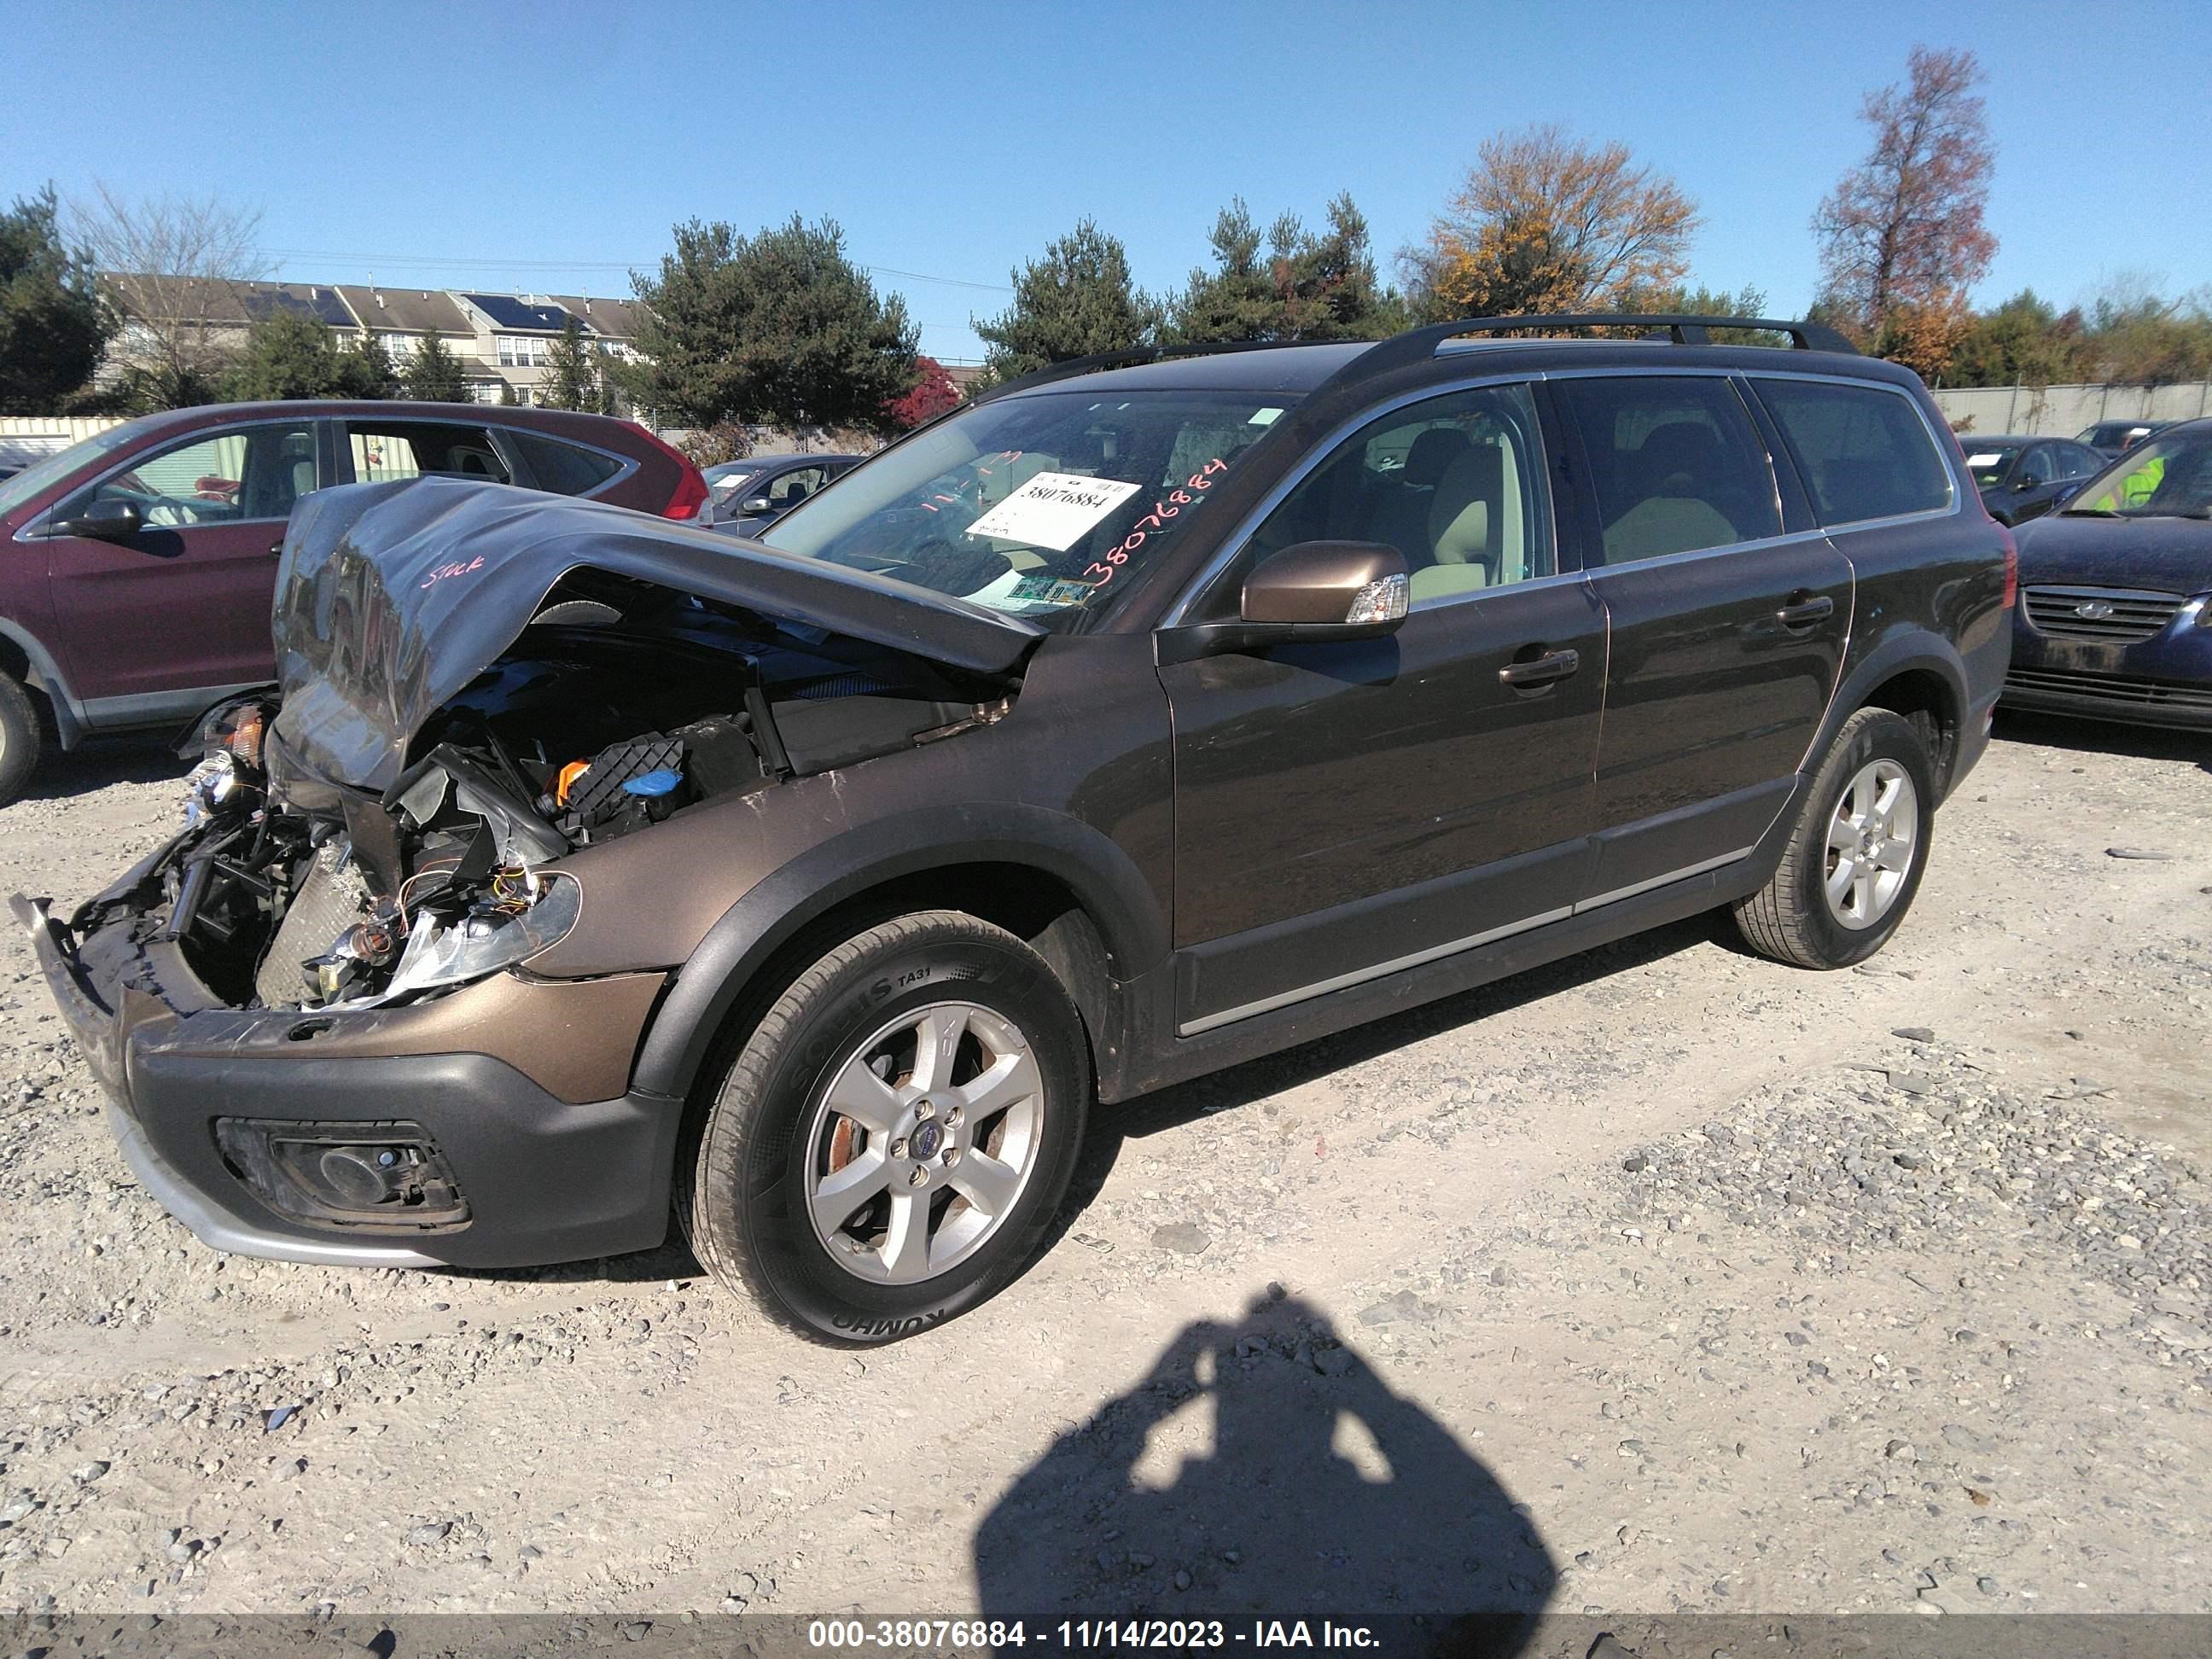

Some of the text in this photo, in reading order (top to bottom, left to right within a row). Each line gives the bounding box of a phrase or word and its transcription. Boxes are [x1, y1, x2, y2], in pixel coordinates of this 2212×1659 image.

[1082, 457, 1229, 588] 38076884
[897, 966, 932, 987] TA31
[830, 1307, 946, 1336] KUMHO
